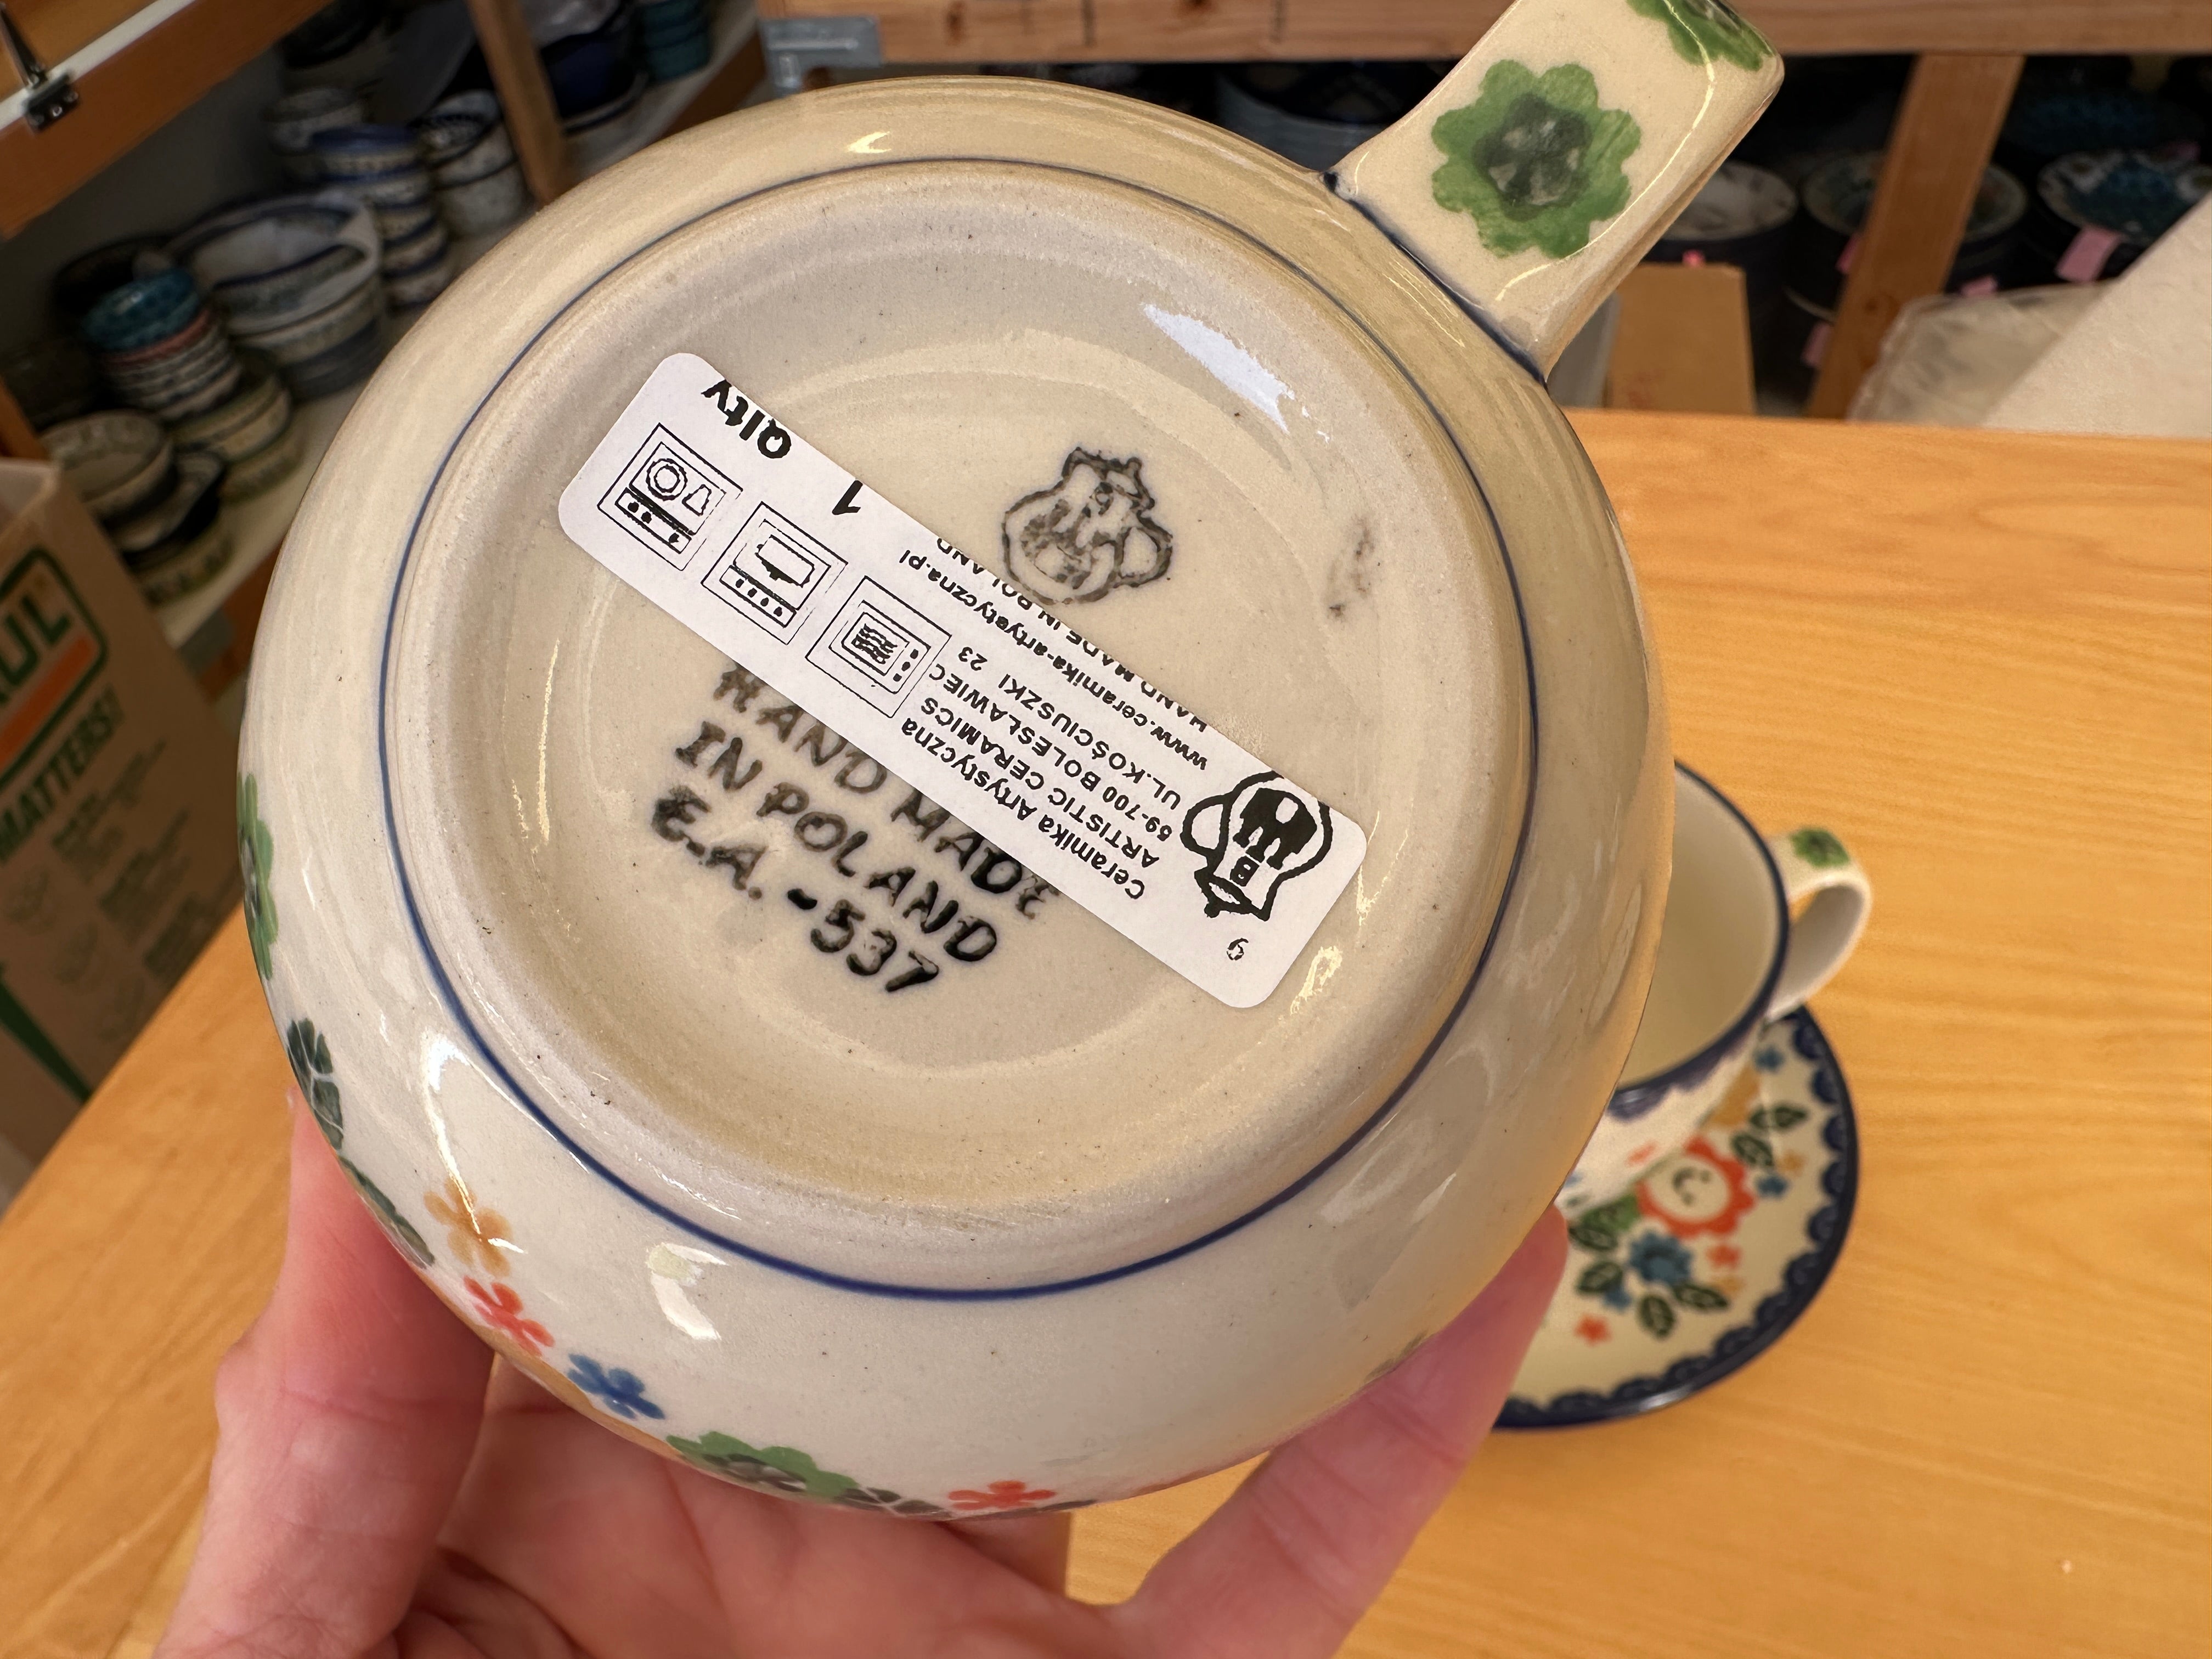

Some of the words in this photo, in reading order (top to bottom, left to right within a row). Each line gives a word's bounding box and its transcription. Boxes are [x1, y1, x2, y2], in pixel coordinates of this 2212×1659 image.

[832, 480, 863, 516] 1
[899, 550, 1207, 770] www.ceramika-artystyczna.pl
[958, 647, 988, 671] 23
[901, 718, 1037, 821] Artystyczna
[921, 697, 1045, 790] CERAMICS
[929, 663, 1101, 792] BOLESŁAWIEC
[998, 674, 1181, 810] UL.KOŚCIUSZKI
[715, 660, 889, 794] HAND
[890, 787, 1062, 919] MADE
[1047, 787, 1160, 868] ARTISTIC
[675, 721, 763, 791] IN
[756, 783, 998, 964] POLAND
[1038, 814, 1145, 900] Ceramika
